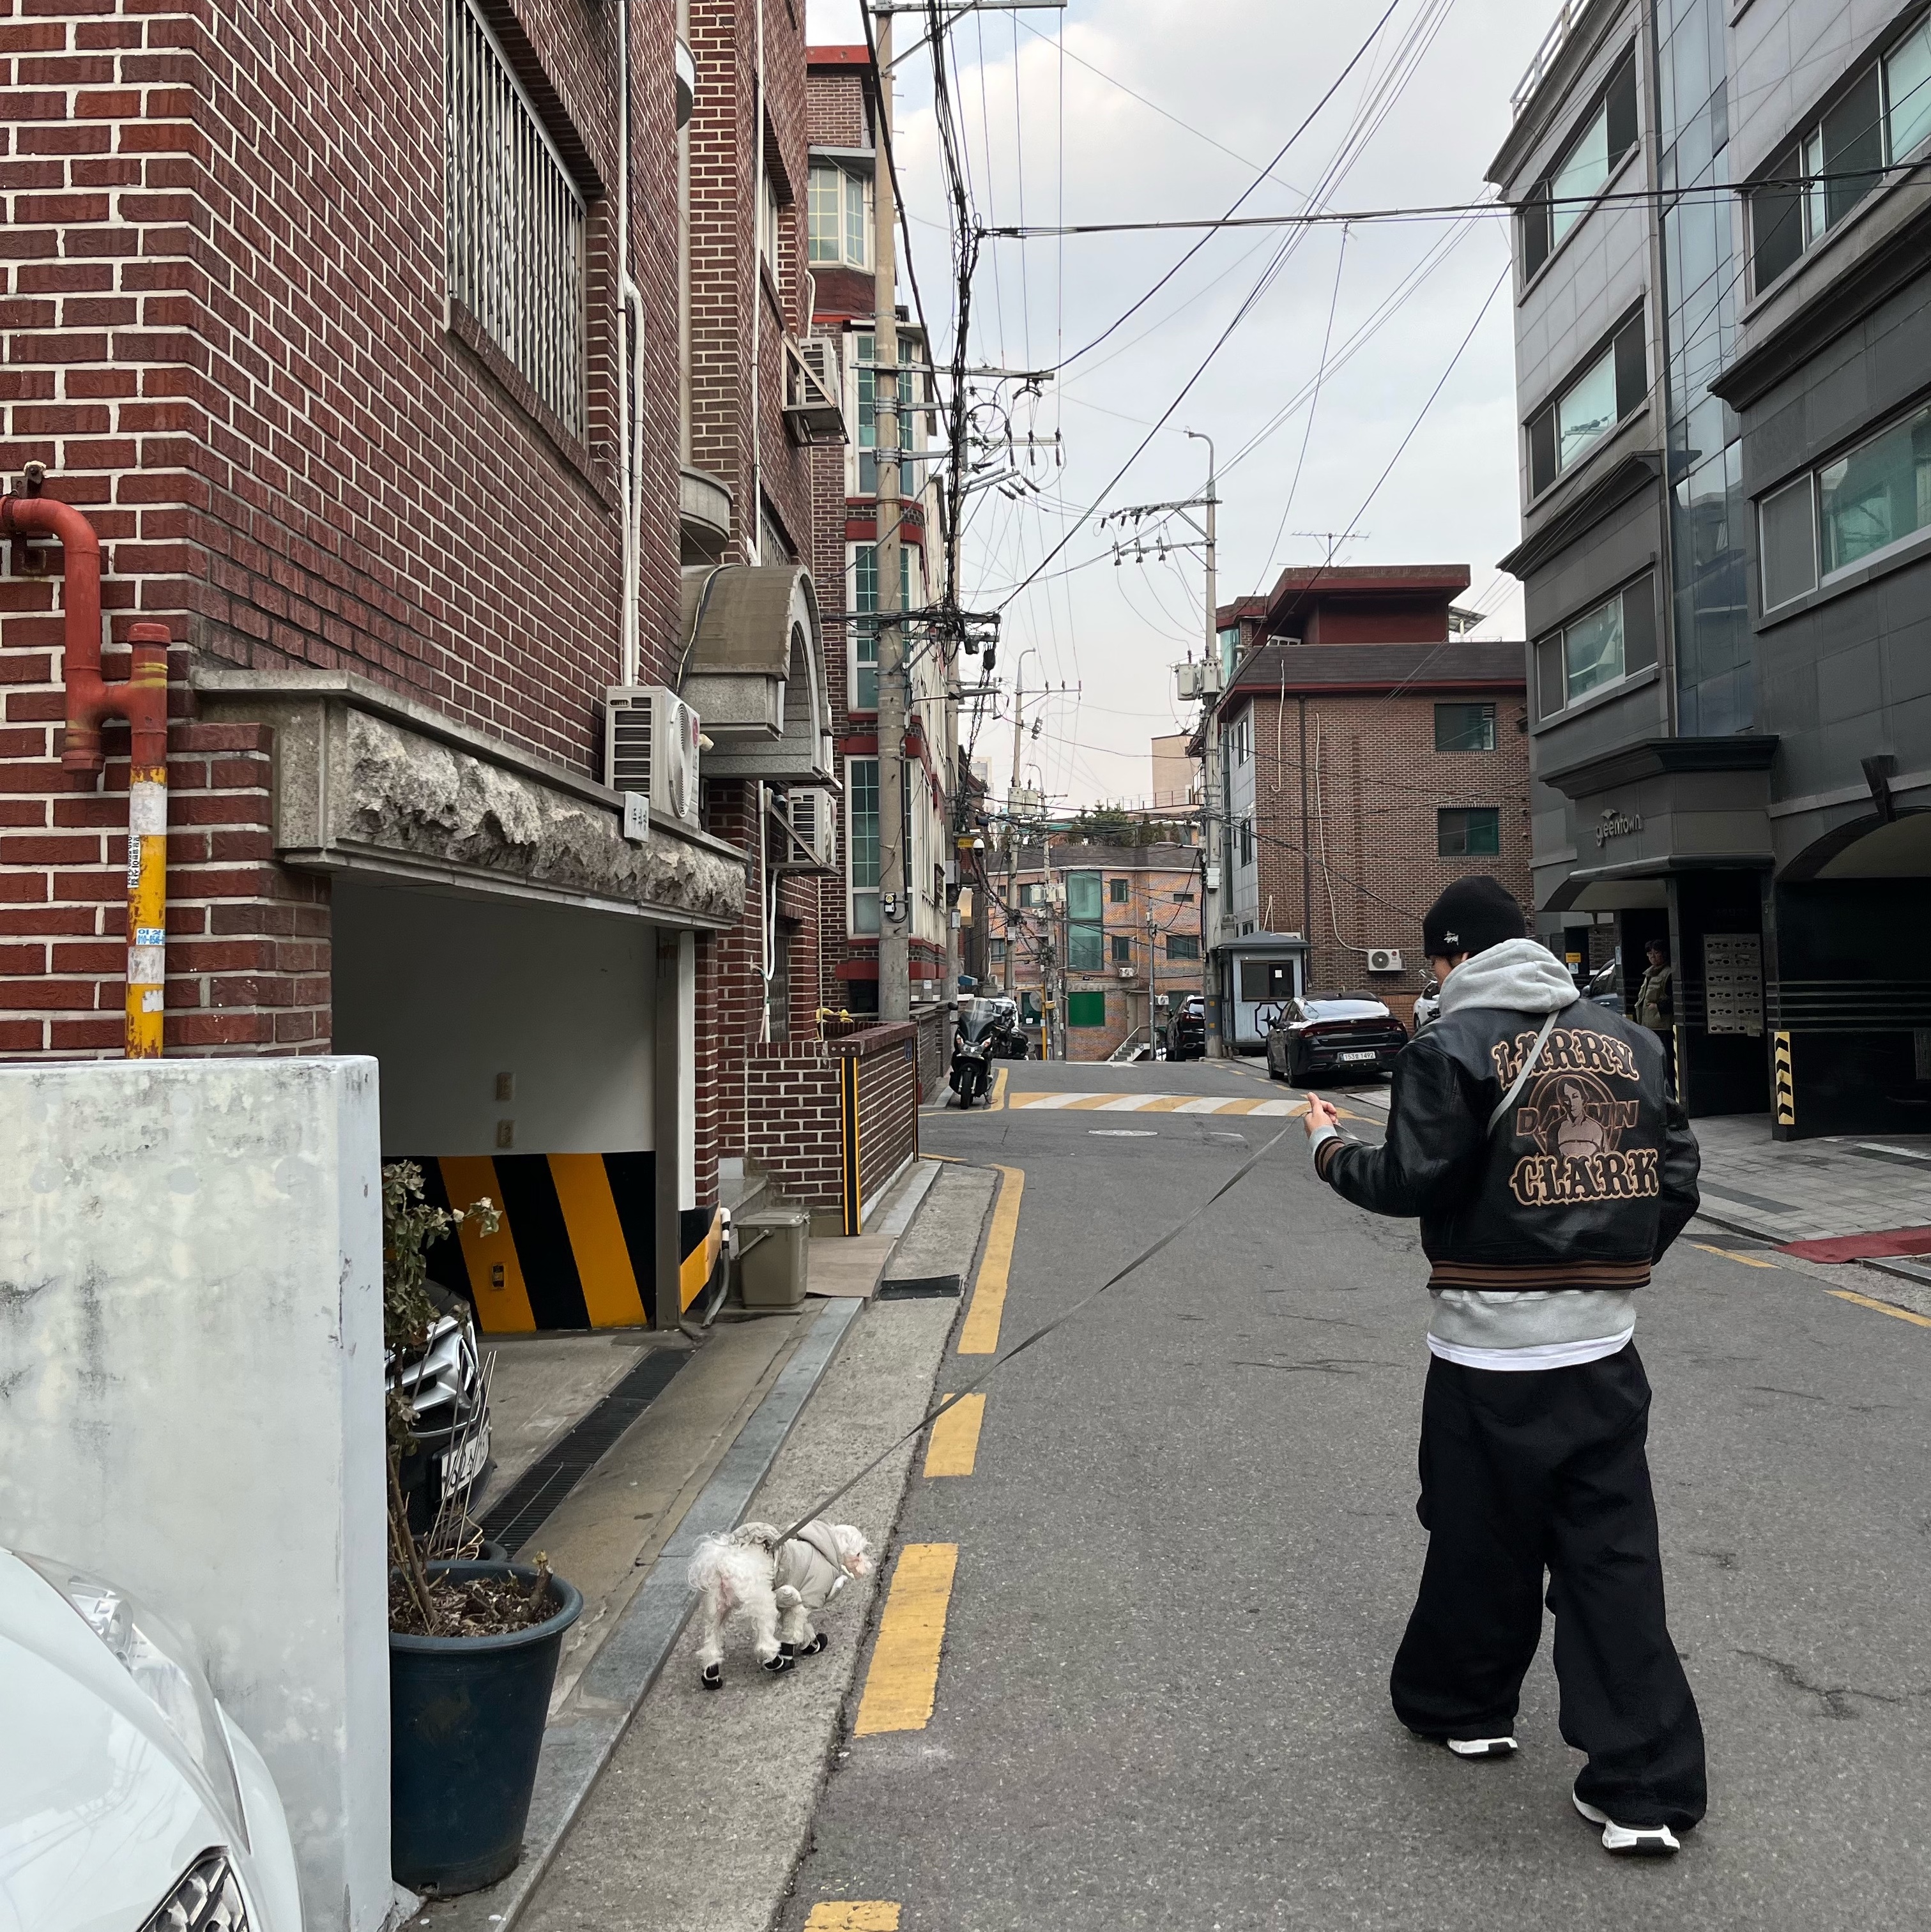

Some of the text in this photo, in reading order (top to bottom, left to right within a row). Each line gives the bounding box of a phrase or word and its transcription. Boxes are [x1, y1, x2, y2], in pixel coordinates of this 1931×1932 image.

[1596, 814, 1642, 847] greentown
[1491, 1028, 1640, 1091] LARRY
[1509, 1148, 1660, 1207] CLARK
